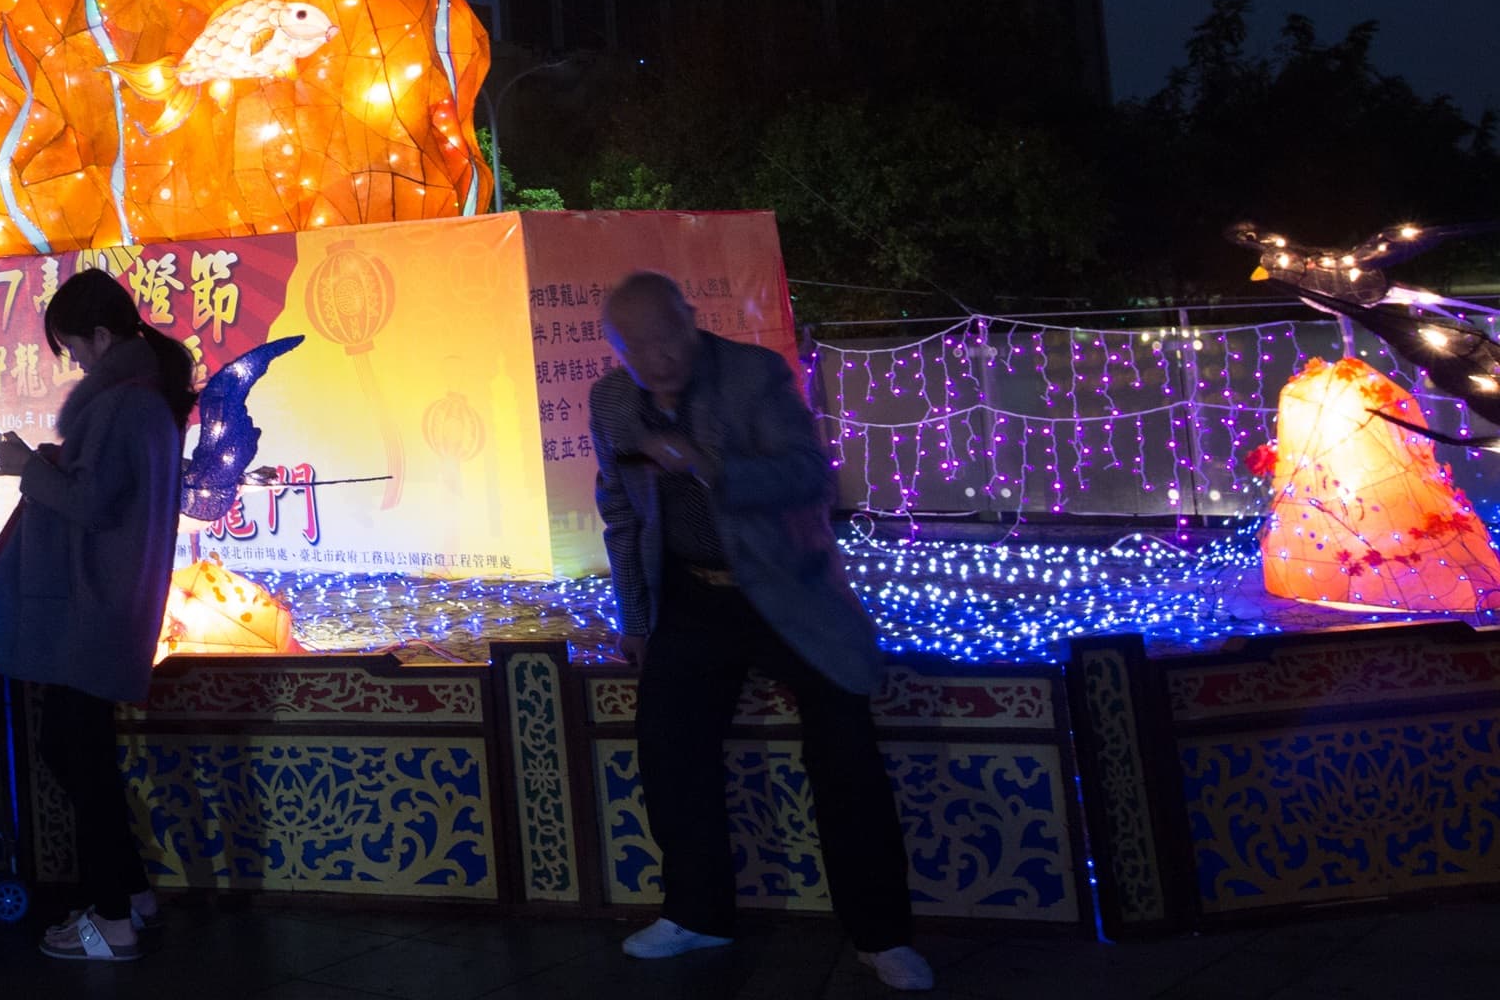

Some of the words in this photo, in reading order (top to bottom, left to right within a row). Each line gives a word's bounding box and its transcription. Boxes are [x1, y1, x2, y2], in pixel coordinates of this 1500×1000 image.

[530, 284, 613, 308] 相傳龍山寺
[536, 356, 620, 384] 現神話故事
